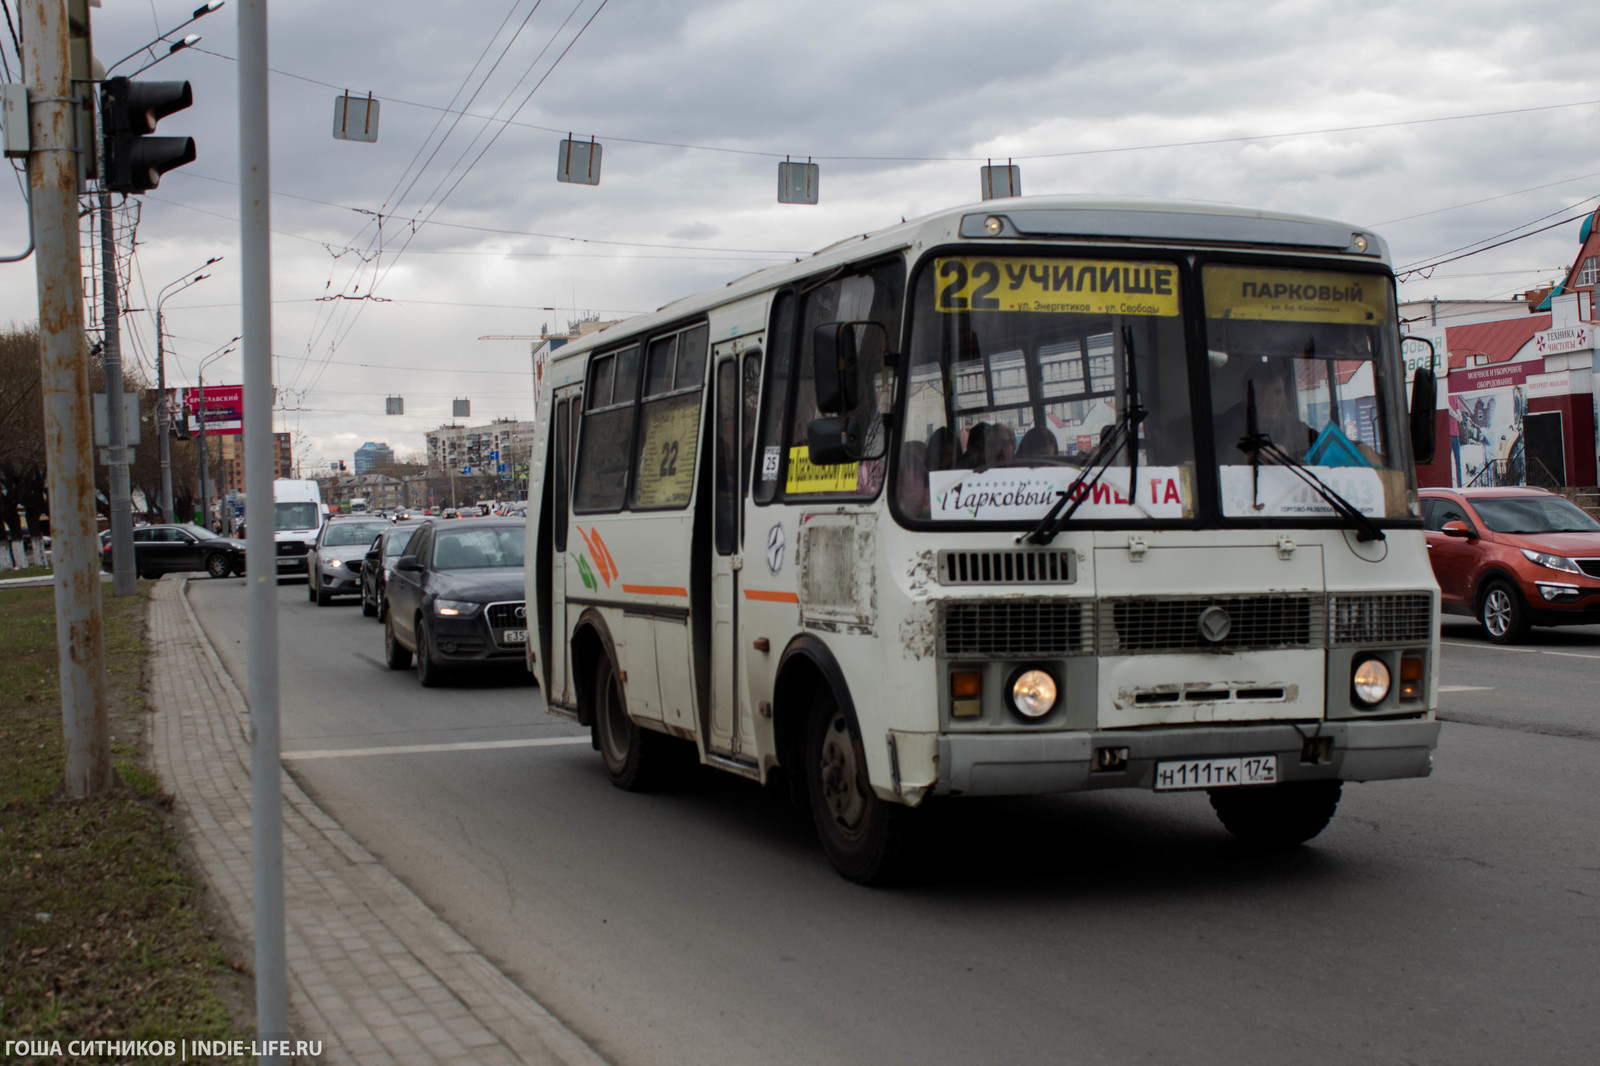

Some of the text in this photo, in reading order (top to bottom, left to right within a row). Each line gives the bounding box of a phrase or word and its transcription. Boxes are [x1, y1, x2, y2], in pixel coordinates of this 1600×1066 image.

[940, 260, 1000, 309] 22
[1004, 263, 1173, 295] УЧИЛИЩЕ
[1241, 281, 1363, 302] ПАРКОВЫЙ
[1017, 302, 1091, 312] ул. Энергетиков
[1105, 303, 1160, 314] ул. Свободы
[1547, 329, 1575, 341] ТЕХНИКА
[660, 440, 679, 477] 22
[766, 456, 776, 471] 25
[1163, 759, 1274, 785] Н111ТК 174
